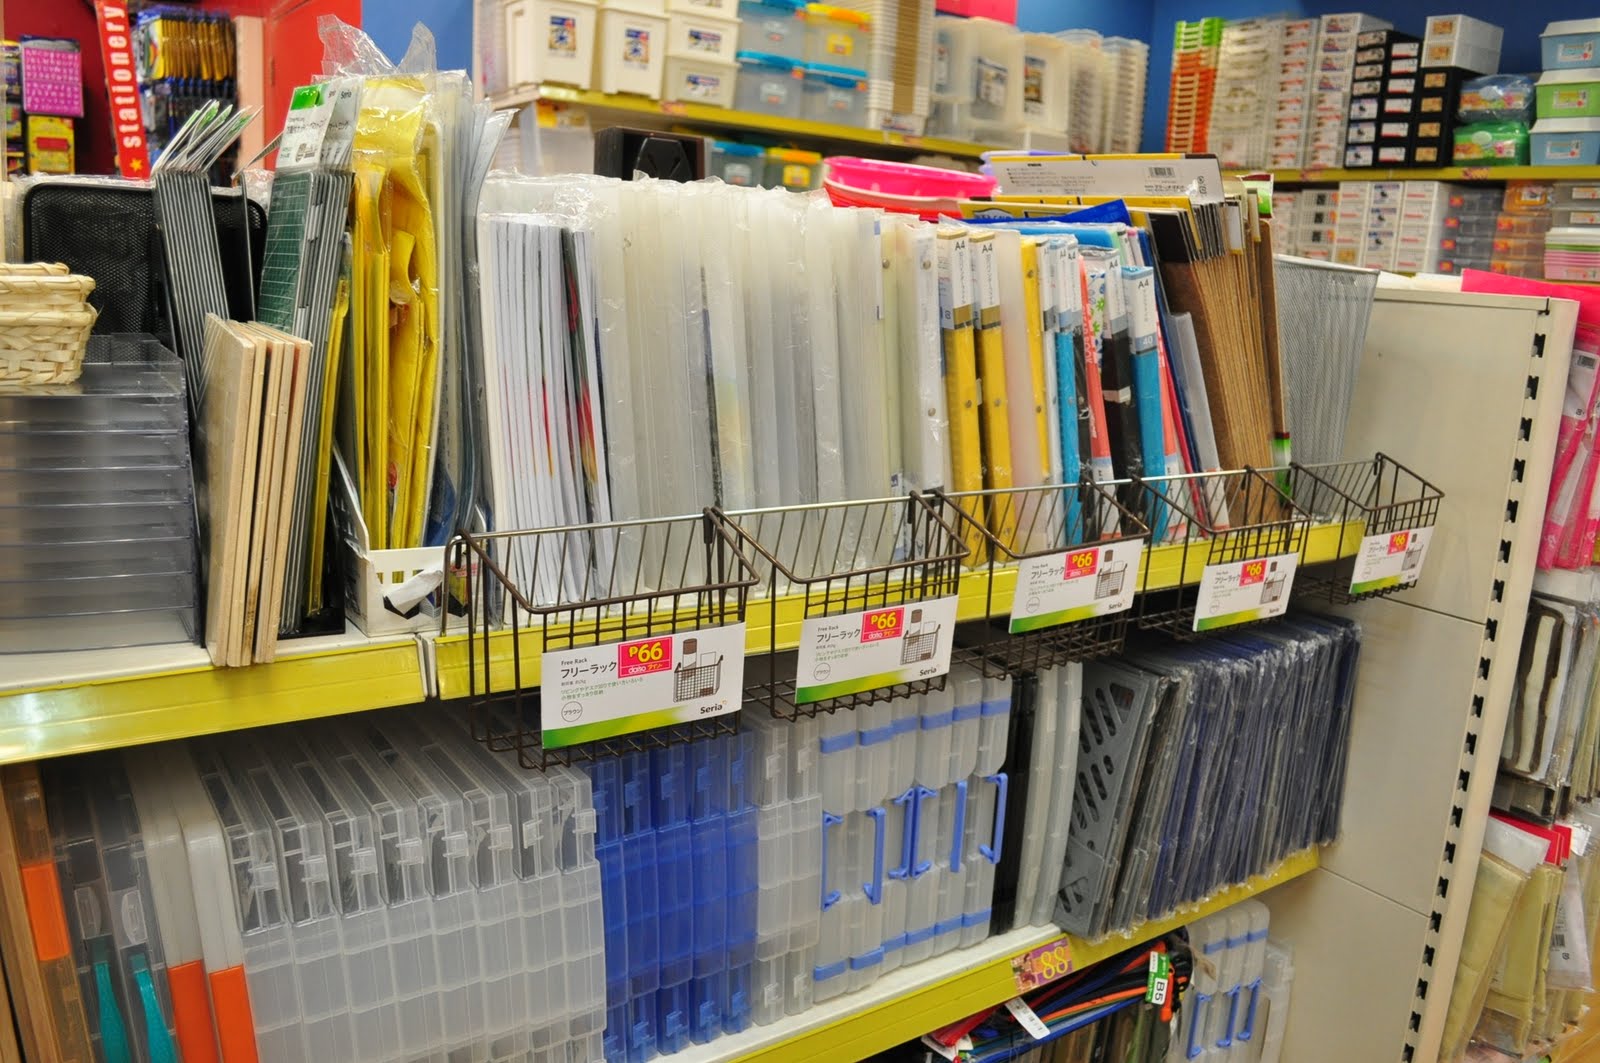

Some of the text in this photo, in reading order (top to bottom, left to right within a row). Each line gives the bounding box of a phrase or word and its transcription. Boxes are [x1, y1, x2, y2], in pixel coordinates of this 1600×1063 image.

[103, 5, 142, 149] stationery
[955, 241, 966, 251] A4
[982, 244, 993, 254] A4
[1109, 260, 1118, 270] A4
[1138, 279, 1149, 289] A4
[1142, 336, 1153, 346] 40
[816, 628, 861, 643] フリーラック
[561, 661, 617, 679] フリーラック
[919, 666, 937, 677] Seria
[563, 708, 581, 716] ブラウン
[700, 703, 723, 714] Seria
[1041, 946, 1068, 980] 88
[1155, 981, 1165, 1002] B5
